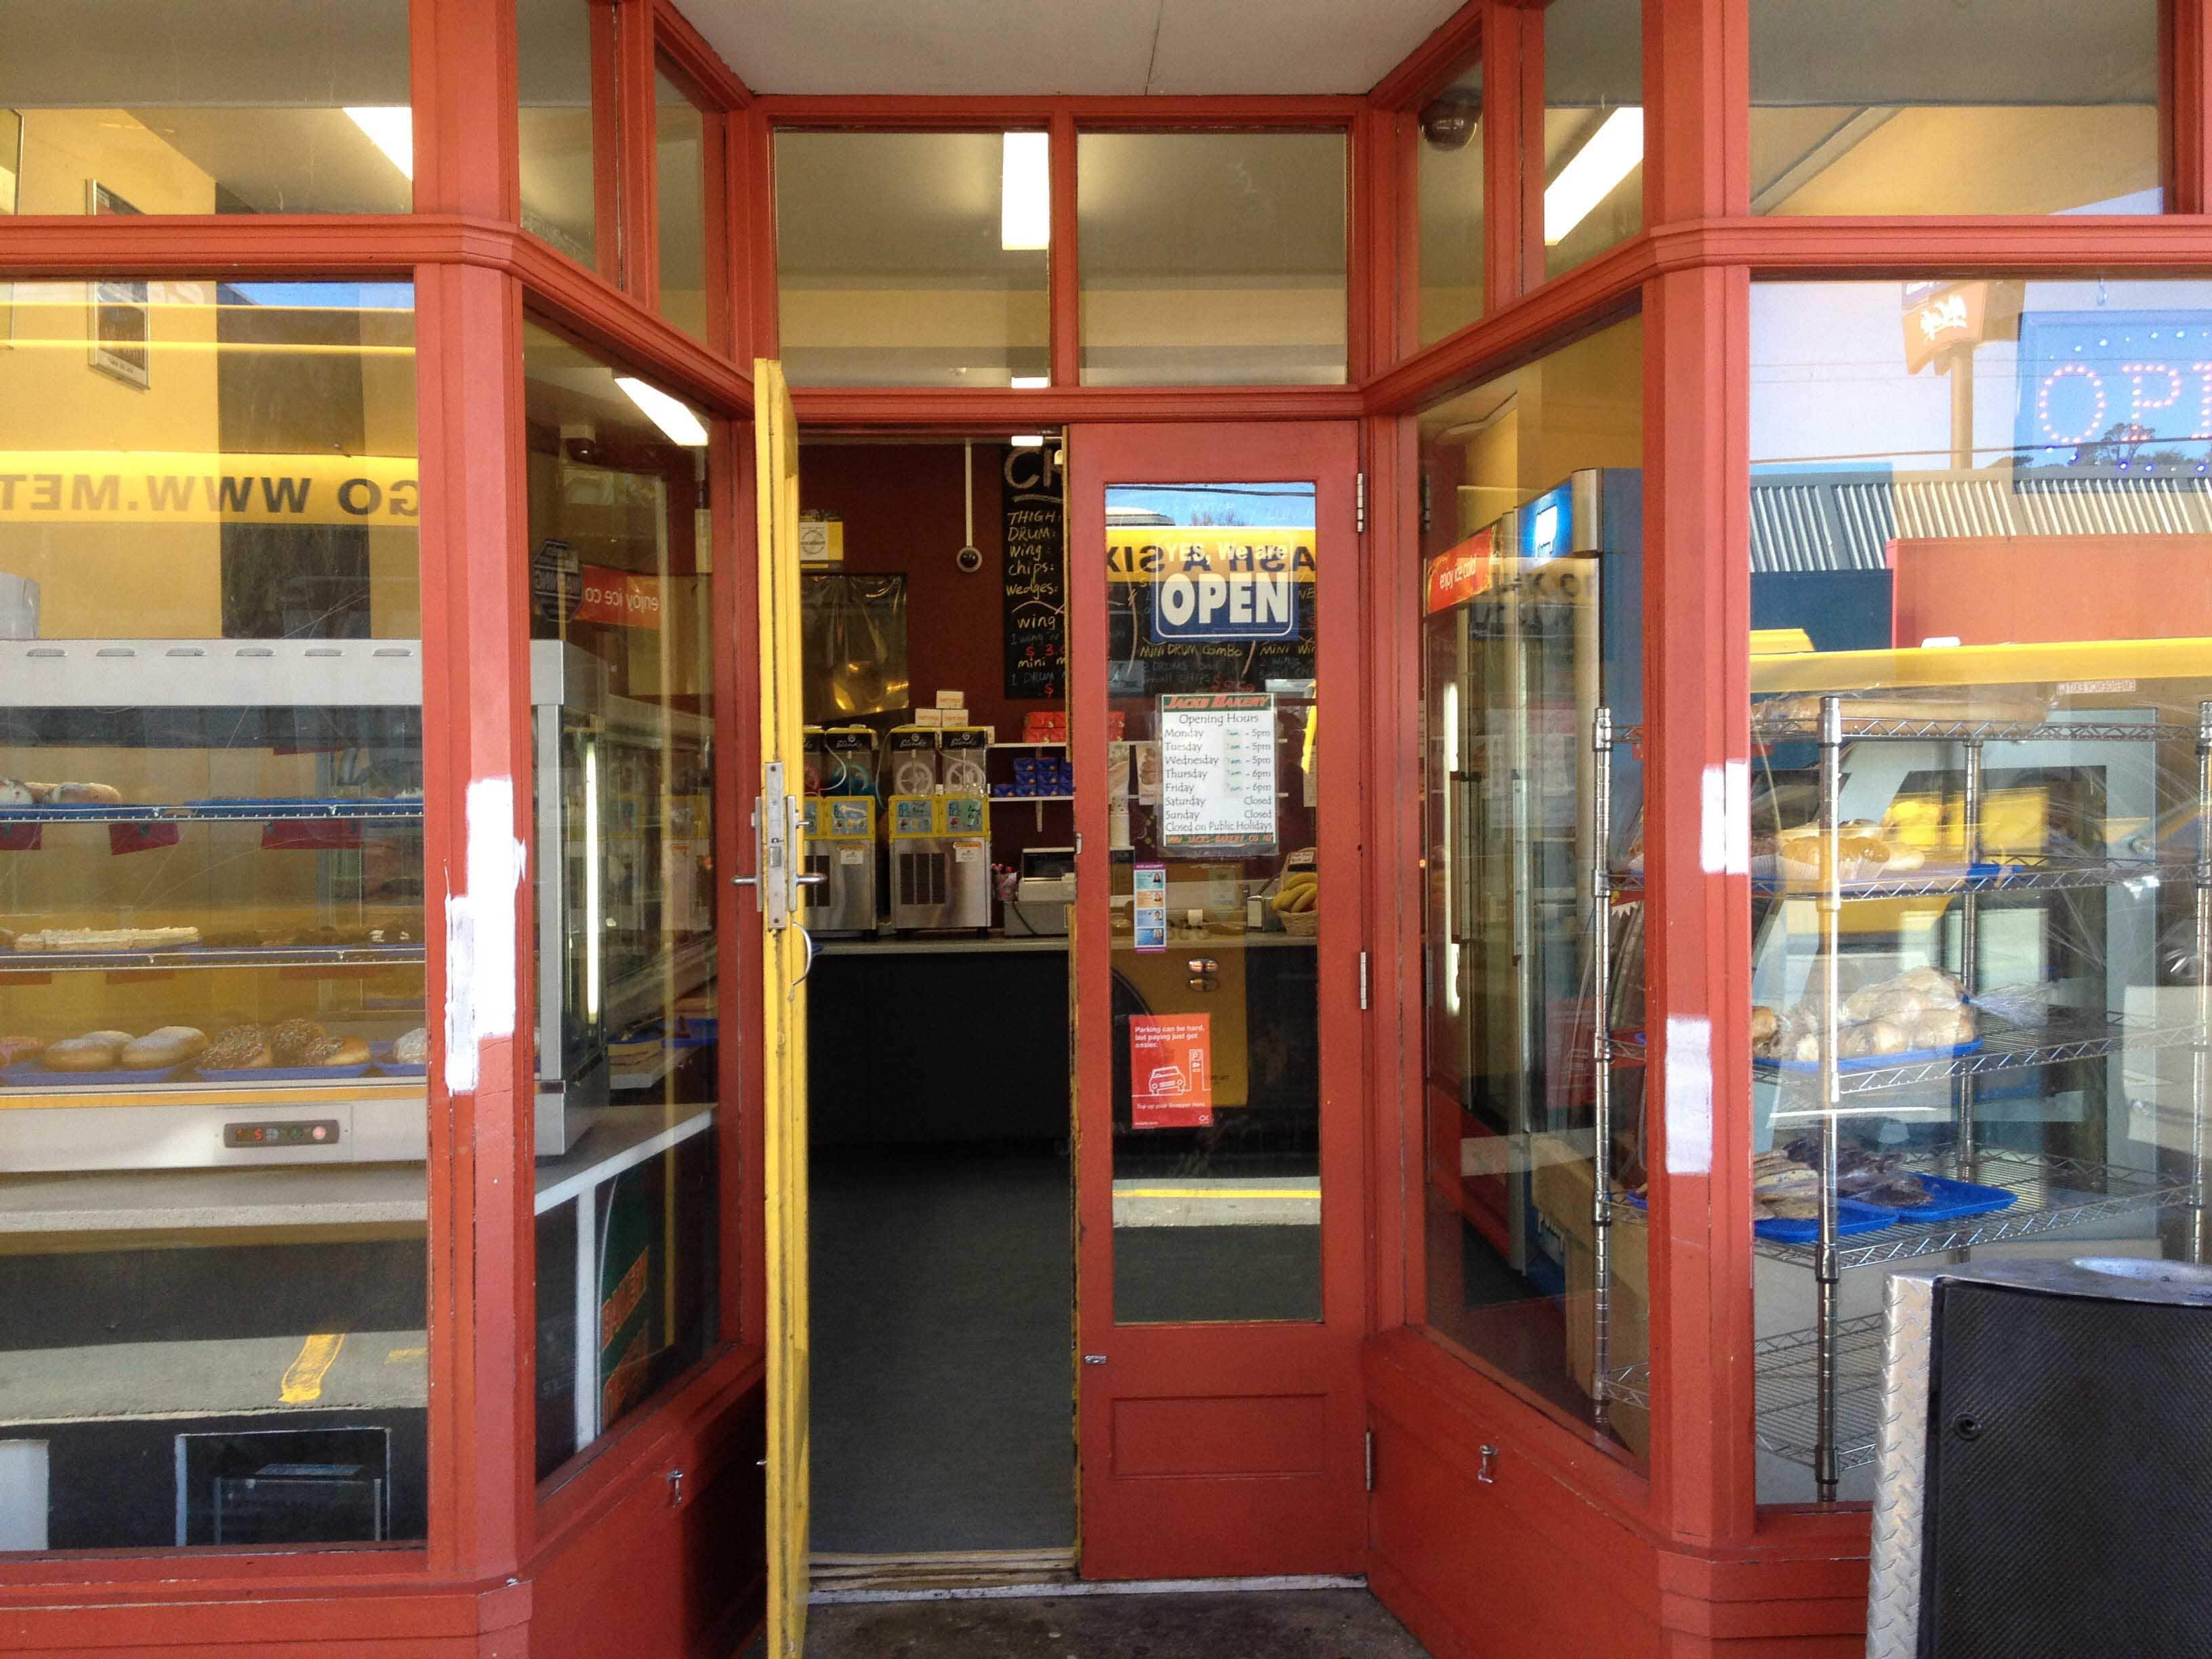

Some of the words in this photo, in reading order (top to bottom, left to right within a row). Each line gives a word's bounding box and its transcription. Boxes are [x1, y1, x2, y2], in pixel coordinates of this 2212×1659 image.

[1164, 542, 1211, 565] YES,
[1216, 542, 1249, 560] We
[1255, 545, 1288, 560] are
[1161, 571, 1288, 626] OPEN
[1179, 714, 1224, 726] Opening
[1227, 713, 1258, 723] Hours
[1164, 729, 1204, 740] Monday
[1252, 729, 1271, 740] 5pm
[1164, 743, 1203, 754] Tuesday
[1252, 743, 1271, 753] 5pm
[1165, 756, 1219, 767] Wednesday
[1252, 756, 1271, 766] 5pm
[1165, 769, 1208, 781] Thursday
[1252, 769, 1271, 780] 6pm
[1165, 783, 1195, 794] Friday
[1252, 783, 1271, 794] 6pm
[1165, 796, 1206, 807] Saturday
[1243, 796, 1271, 805] Closed
[1165, 810, 1200, 821] Sunday
[1244, 809, 1271, 819] Closed
[1166, 821, 1193, 832] Closed
[1195, 823, 1206, 832] on
[1208, 821, 1234, 831] Public
[1236, 821, 1273, 832] Holidays
